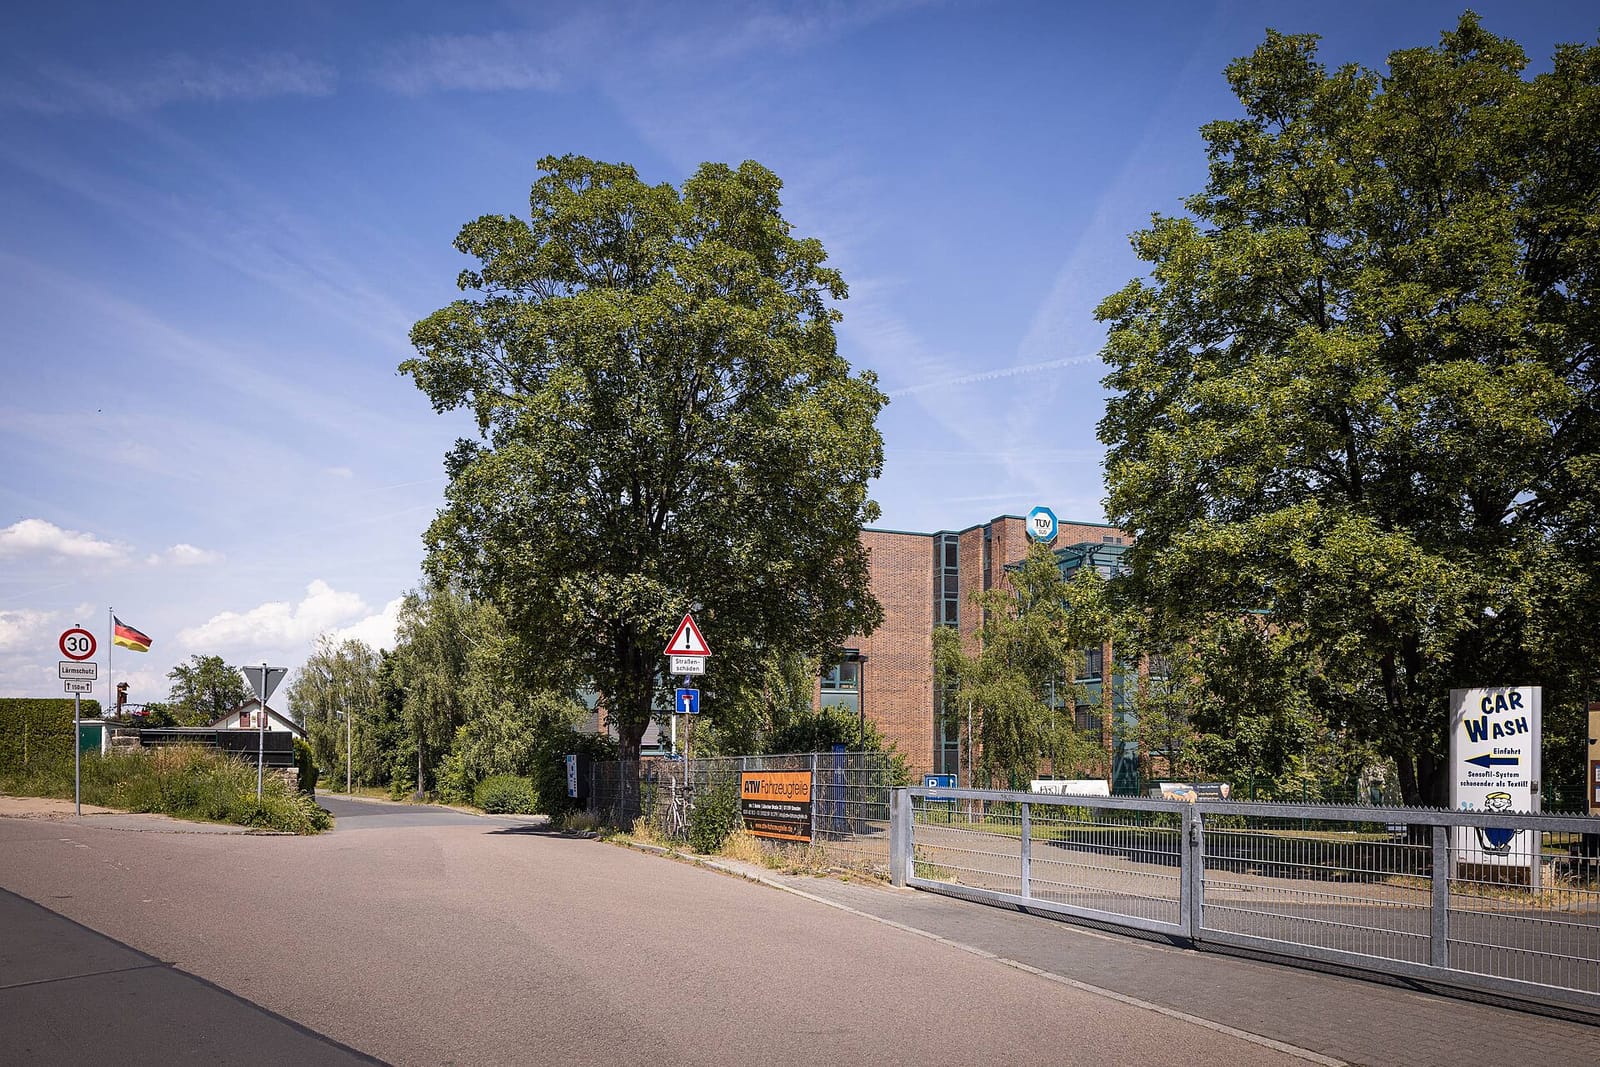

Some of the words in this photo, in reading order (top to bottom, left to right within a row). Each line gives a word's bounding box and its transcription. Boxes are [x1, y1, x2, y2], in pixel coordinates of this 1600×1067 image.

[1034, 518, 1051, 528] TÜV
[67, 637, 89, 652] 30
[62, 667, 95, 675] Lärmschutz
[1481, 692, 1524, 715] CAR
[1464, 715, 1529, 743] WASH
[1493, 747, 1521, 755] Einfahrt
[744, 780, 761, 794] ATW
[761, 779, 809, 799] Fahrzeugteile
[1460, 780, 1494, 788] schonender
